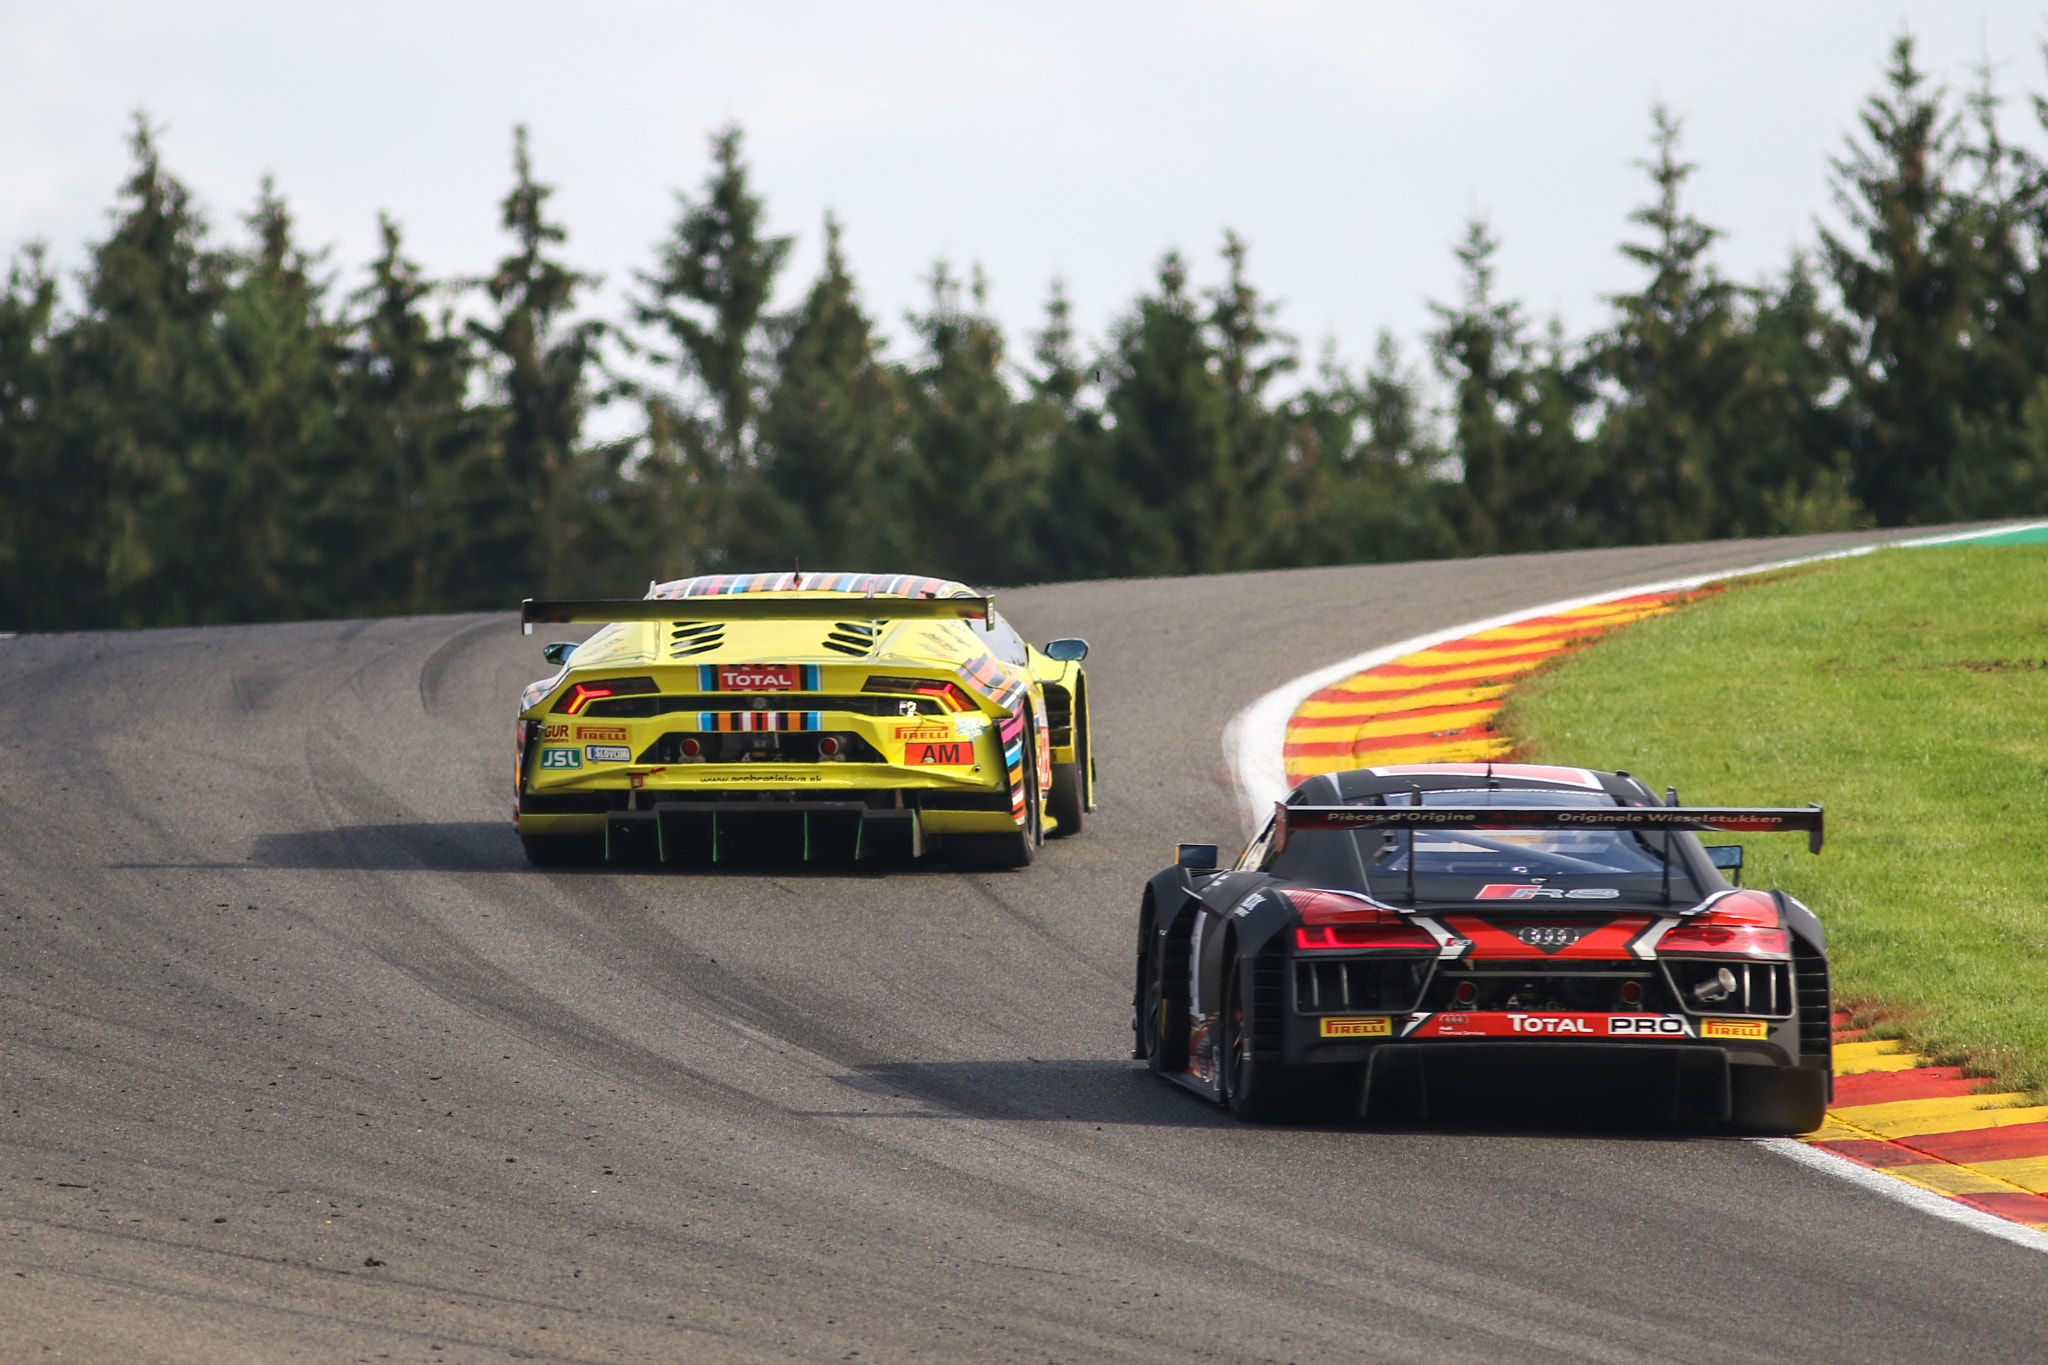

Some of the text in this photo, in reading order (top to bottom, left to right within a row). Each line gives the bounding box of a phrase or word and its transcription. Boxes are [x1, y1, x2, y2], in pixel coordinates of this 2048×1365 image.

[722, 672, 792, 686] TOTAL
[544, 725, 569, 738] GUR
[576, 726, 627, 741] PIRELLI
[894, 726, 949, 740] PIRELLI
[543, 751, 579, 766] JSL
[920, 744, 960, 763] AM
[1327, 811, 1477, 823] Pièces d'Origine
[1490, 812, 1546, 822] Audi
[1557, 813, 1783, 824] Originele Wisselstukken
[1508, 887, 1620, 899] R8
[1326, 1018, 1386, 1034] PIRELLI
[1507, 1014, 1594, 1033] TOTAL
[1611, 1018, 1683, 1034] PRO
[1707, 1020, 1763, 1037] PIRELLI
